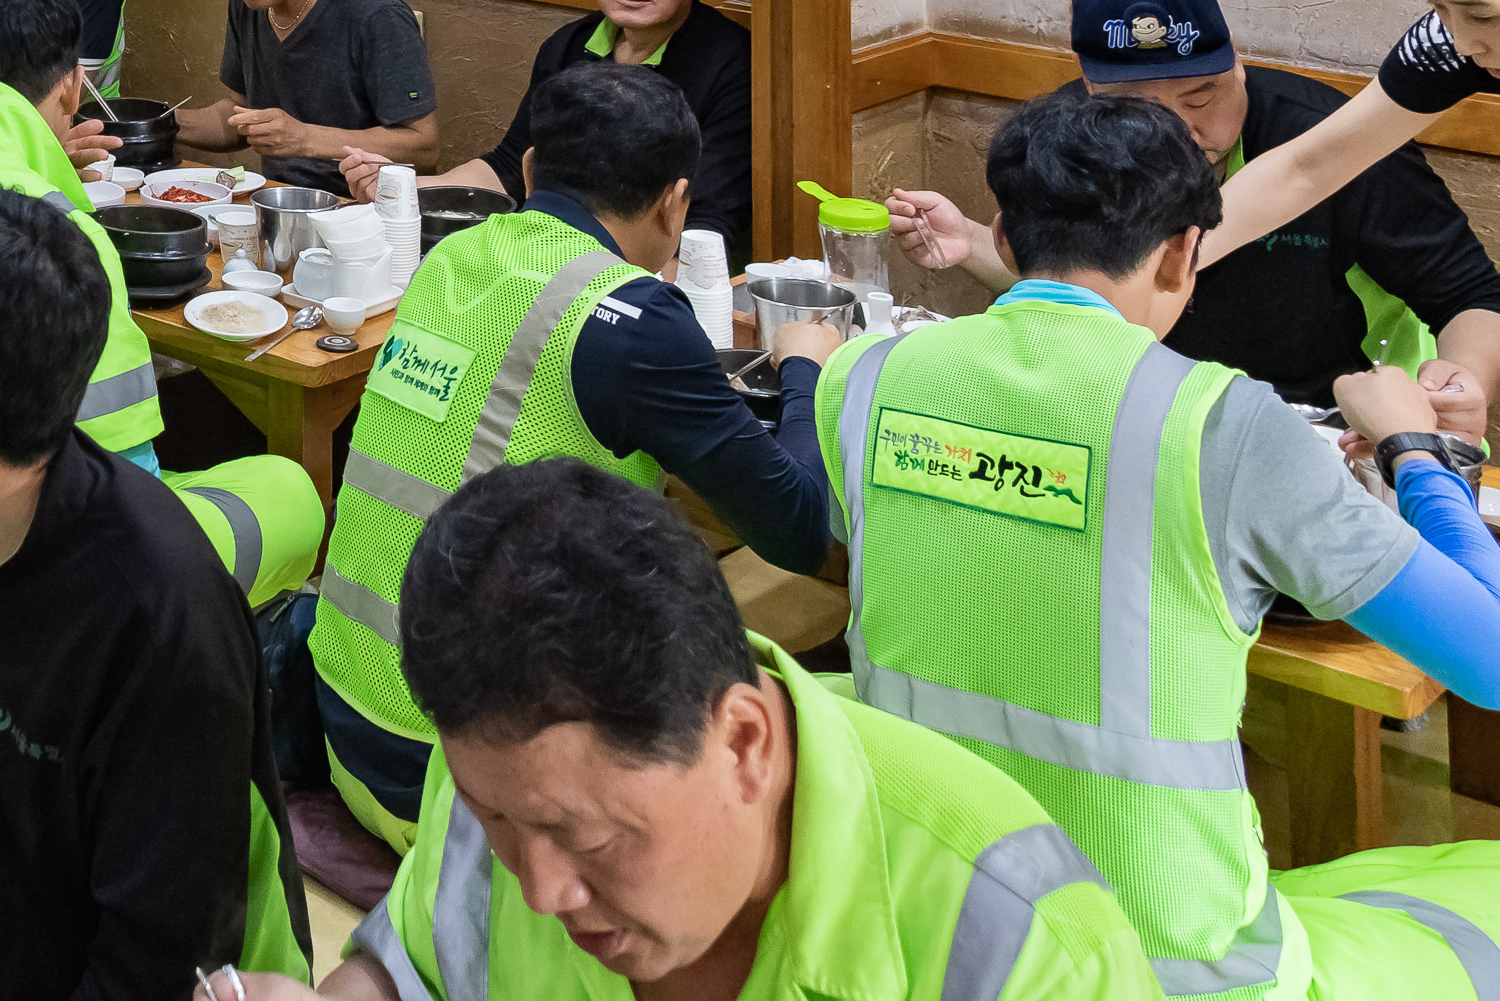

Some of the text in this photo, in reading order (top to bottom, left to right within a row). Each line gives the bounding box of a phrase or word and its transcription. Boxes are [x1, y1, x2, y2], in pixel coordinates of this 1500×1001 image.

[879, 429, 973, 464] 구민이 꿈꾸는 가치
[894, 450, 1046, 498] 함께 만드는 광진
